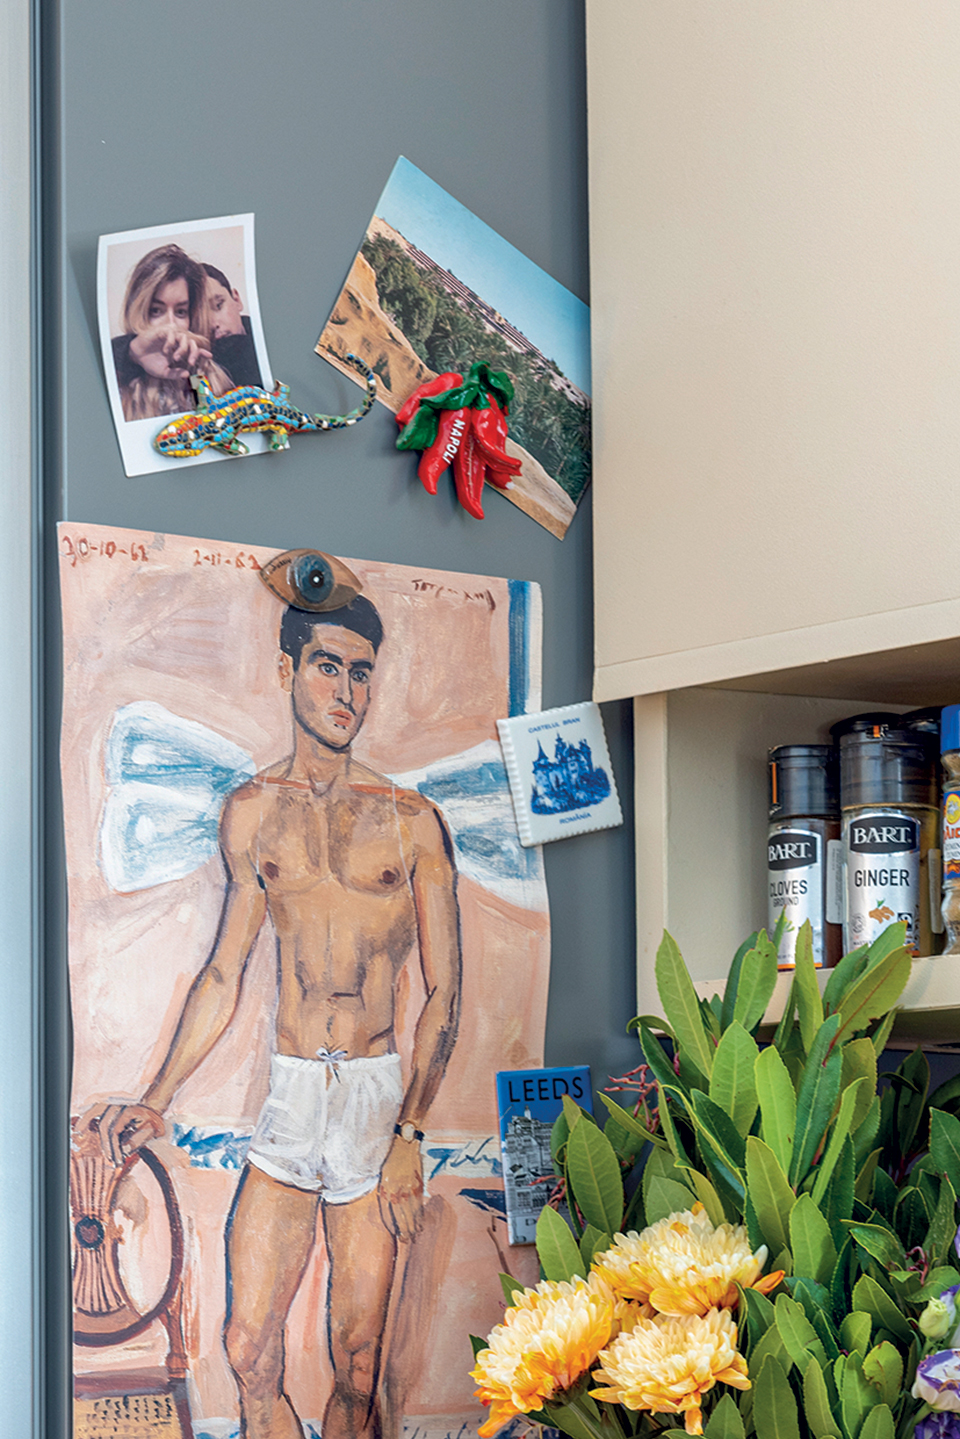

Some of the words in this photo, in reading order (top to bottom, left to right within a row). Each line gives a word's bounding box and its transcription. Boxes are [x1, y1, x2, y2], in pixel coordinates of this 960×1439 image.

[442, 419, 466, 465] NAPOLI
[528, 722, 560, 734] CASTELUL
[562, 717, 581, 726] BRAN
[853, 826, 911, 844] BART
[769, 842, 811, 862] BART
[854, 869, 910, 887] GINGER
[508, 1076, 584, 1102] LEEDS
